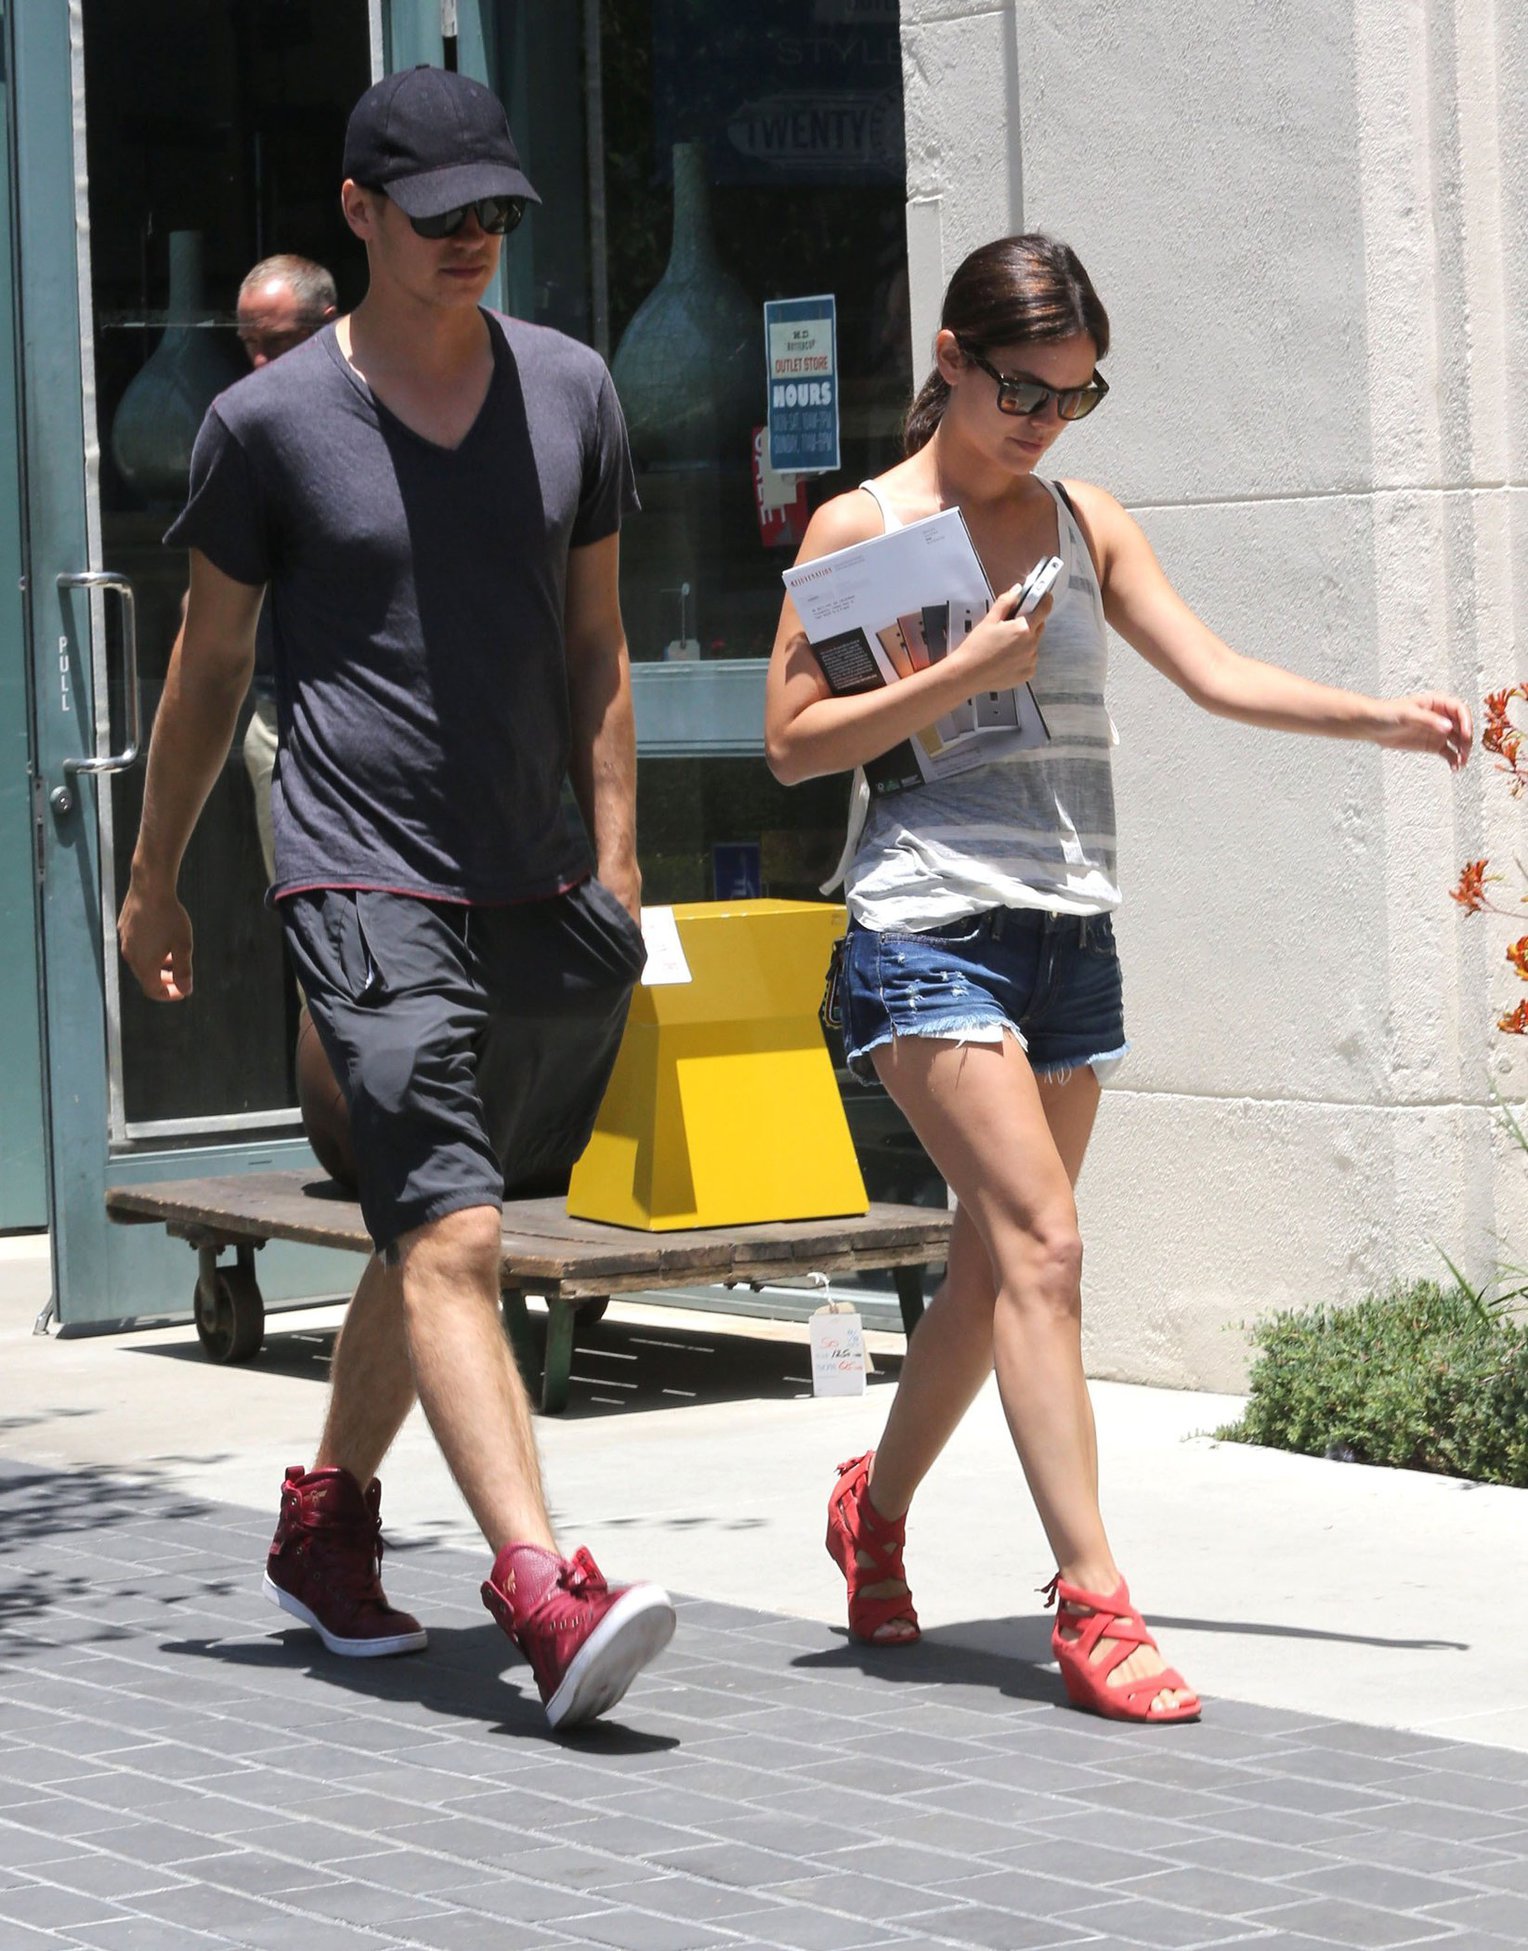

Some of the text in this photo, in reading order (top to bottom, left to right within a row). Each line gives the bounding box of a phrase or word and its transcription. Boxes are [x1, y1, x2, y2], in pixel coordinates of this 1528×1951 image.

[775, 355, 829, 374] OUTLET STORE
[773, 382, 832, 408] HOURS
[58, 636, 71, 712] PULL
